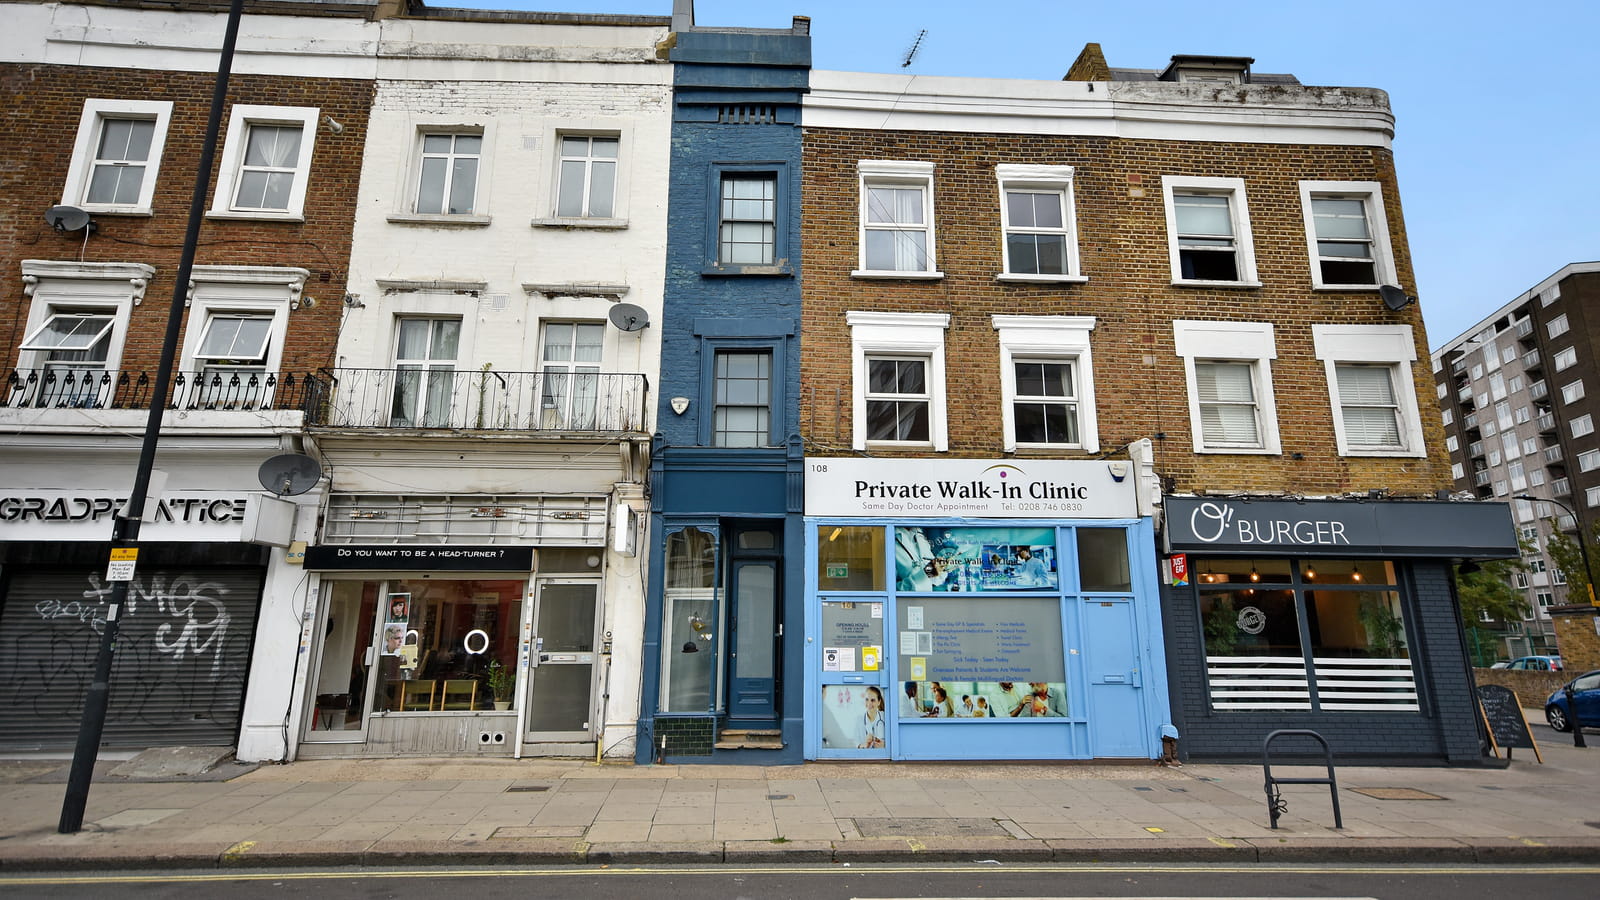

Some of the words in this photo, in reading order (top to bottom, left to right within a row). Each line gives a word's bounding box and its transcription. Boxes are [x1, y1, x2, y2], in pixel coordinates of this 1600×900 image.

[811, 465, 828, 473] 108
[855, 480, 931, 498] Private
[937, 480, 1022, 499] Walk-In
[1029, 481, 1088, 499] Clinic
[862, 502, 885, 510] Same
[888, 502, 904, 512] Day
[907, 502, 933, 510] Doctor
[937, 502, 989, 512] Appointment
[1002, 503, 1015, 511] Tel:
[1019, 503, 1040, 511] 0208
[1043, 503, 1058, 511] 746
[1061, 503, 1082, 511] 0830
[1238, 519, 1350, 544] BURGER
[438, 550, 497, 558] HEAD-TURNER
[499, 550, 504, 558] ?
[1172, 557, 1184, 566] JUST
[1175, 565, 1185, 574] EAT
